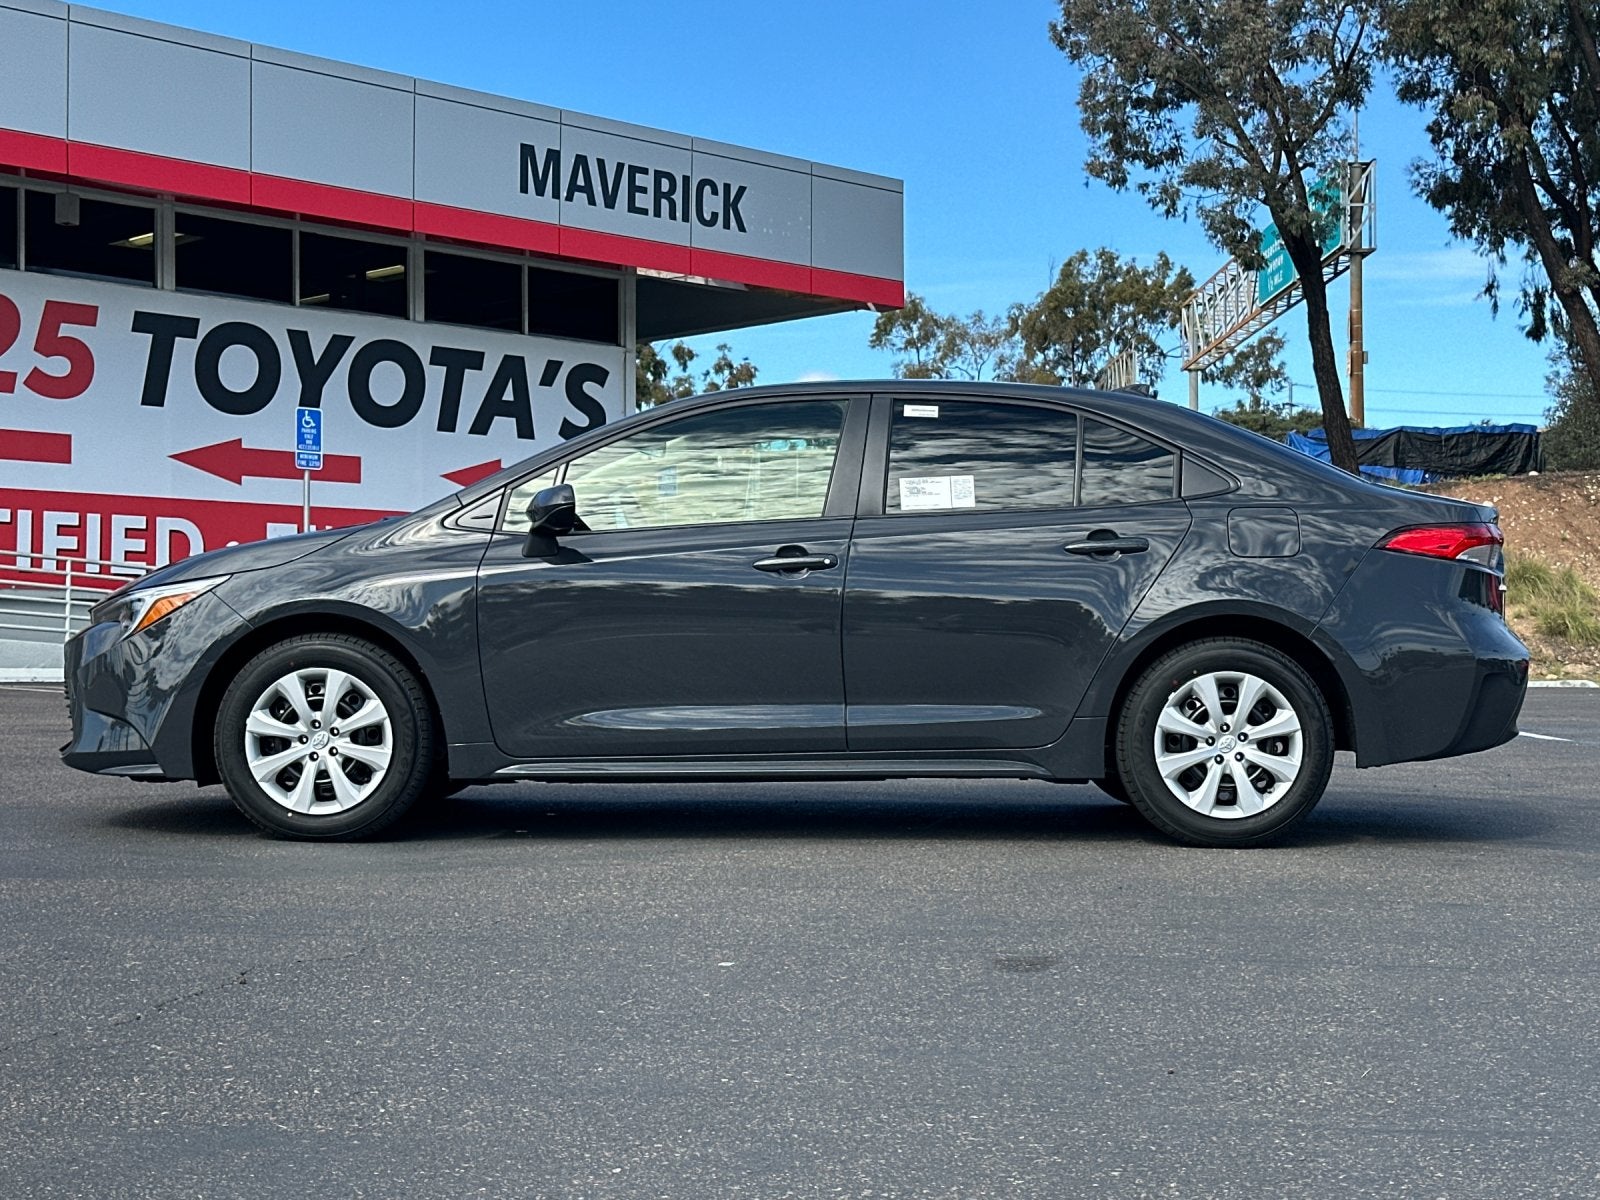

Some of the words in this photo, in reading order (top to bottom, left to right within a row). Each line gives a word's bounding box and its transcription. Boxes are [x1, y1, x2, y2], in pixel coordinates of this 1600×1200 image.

[519, 142, 747, 234] MAVERICK
[0, 292, 99, 400] 5
[131, 310, 610, 441] TOYOTA'S
[0, 508, 205, 575] IFIED
